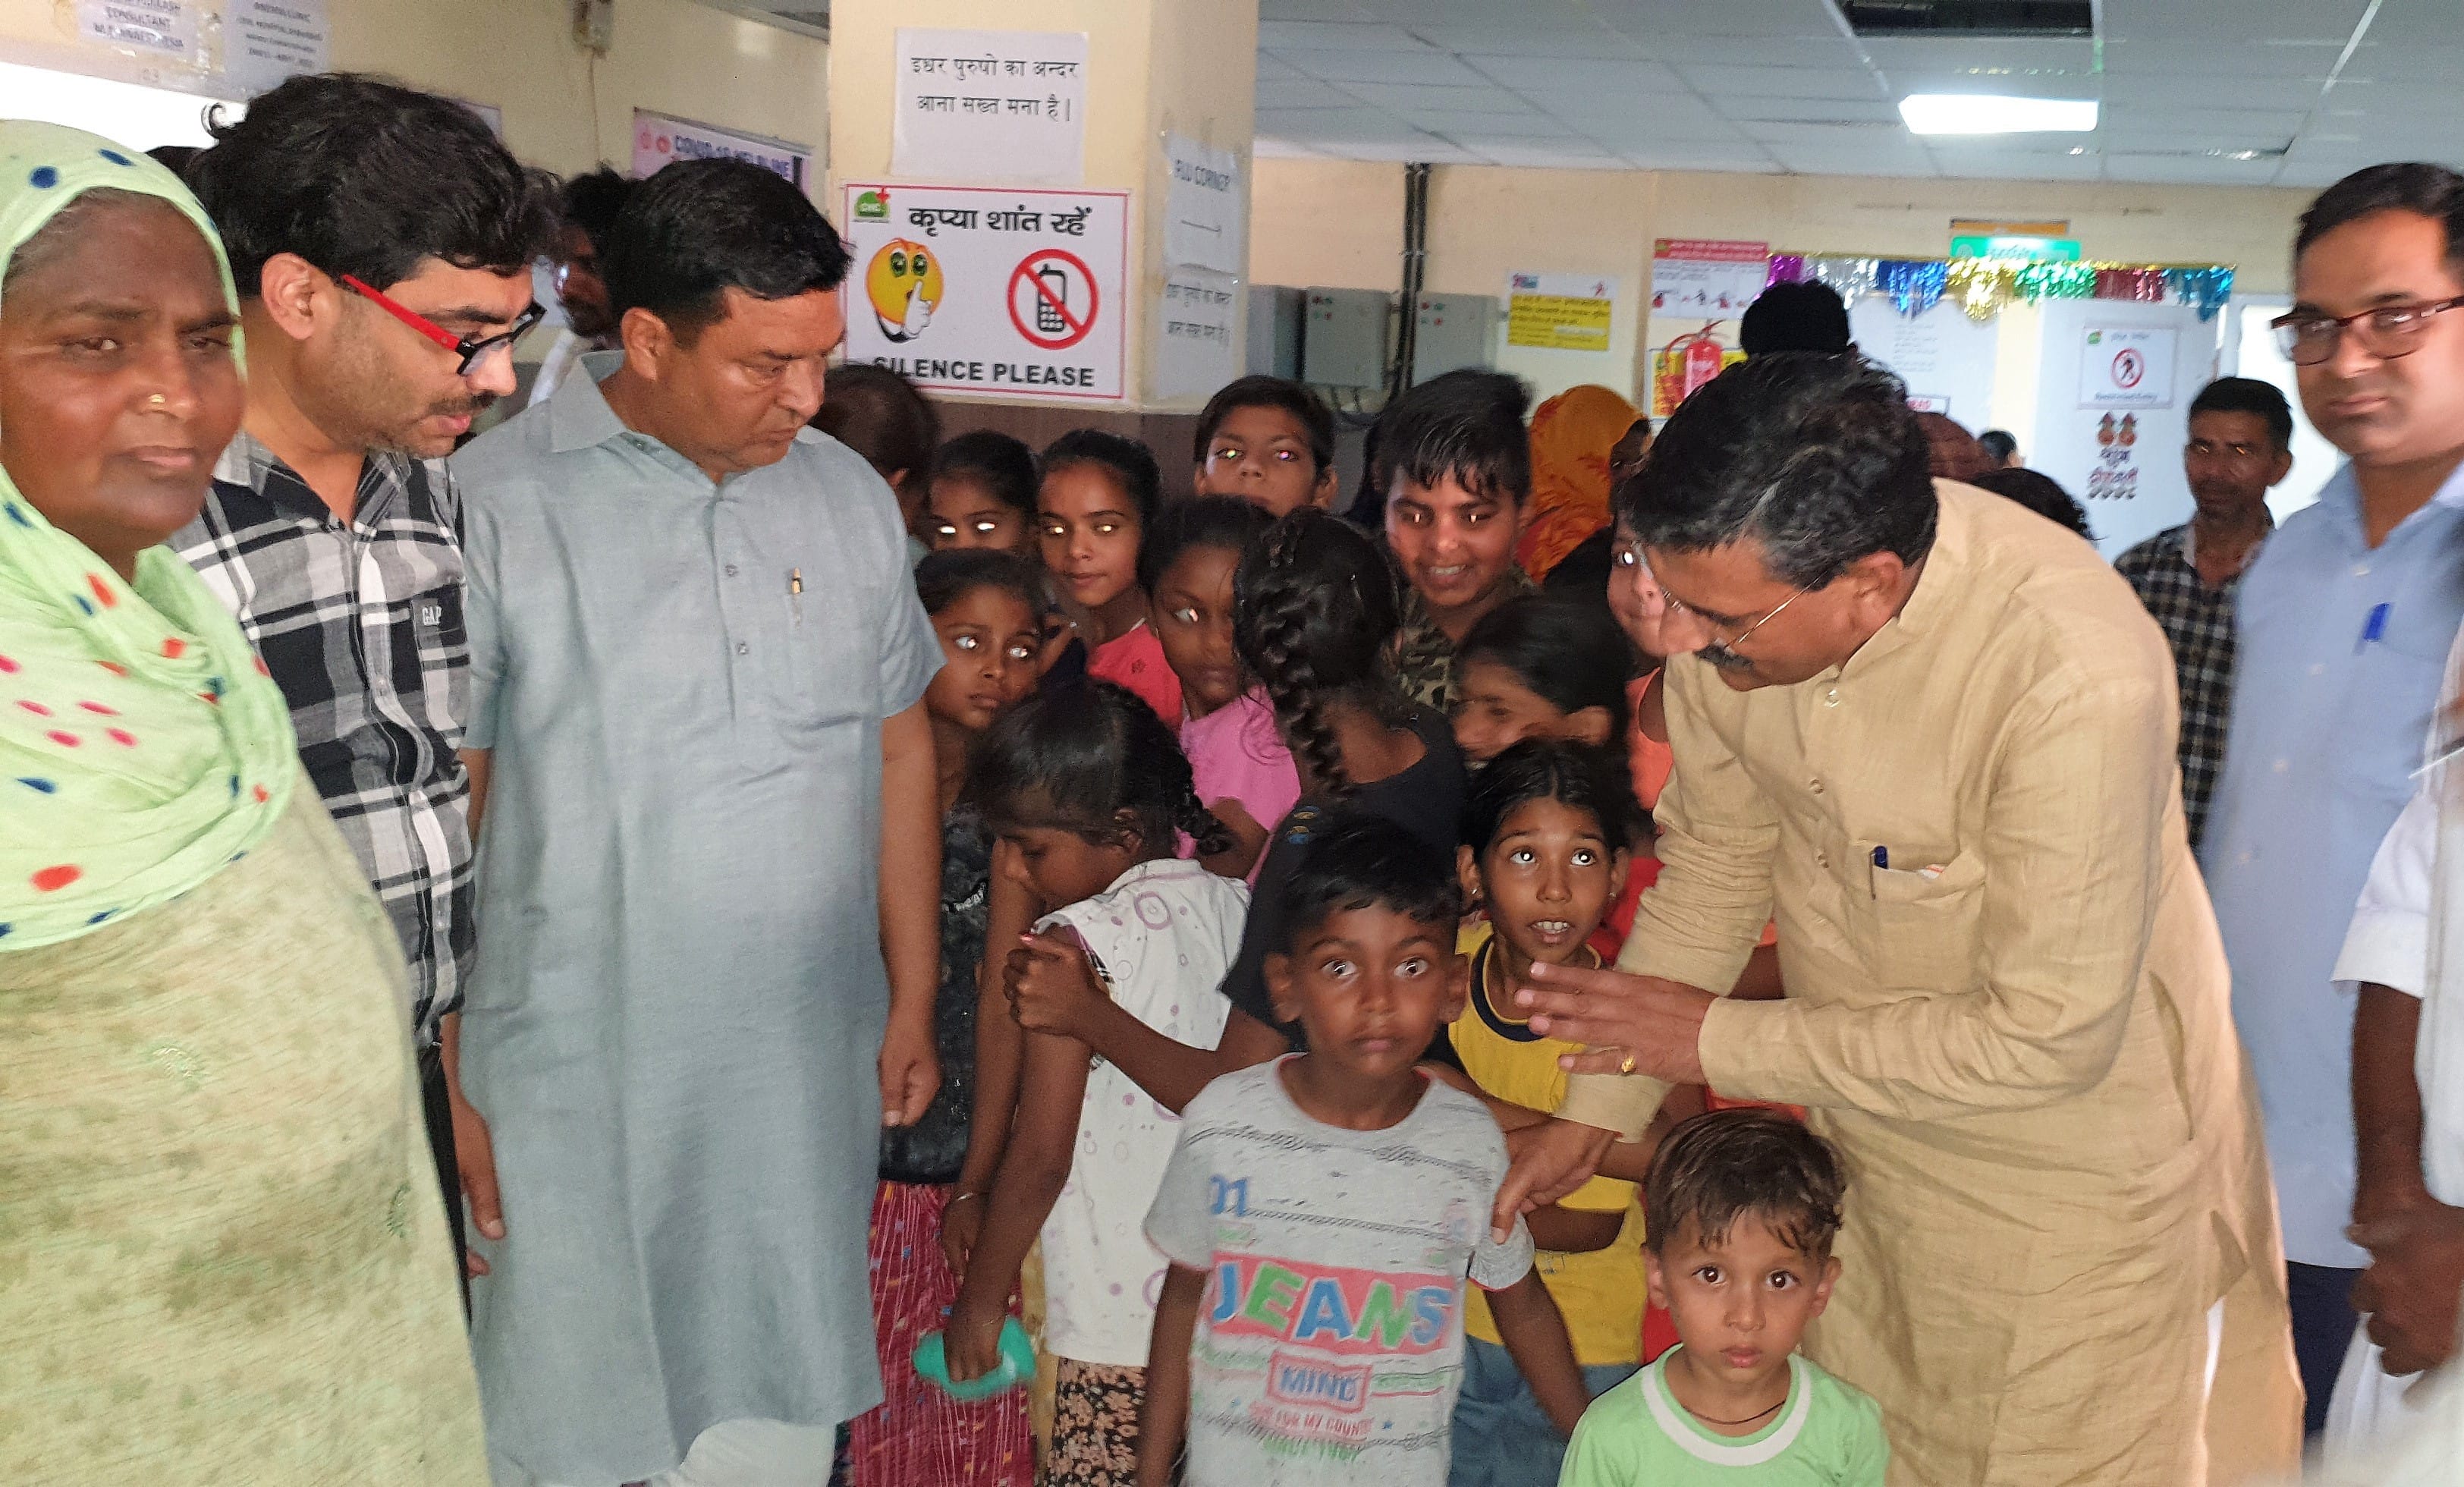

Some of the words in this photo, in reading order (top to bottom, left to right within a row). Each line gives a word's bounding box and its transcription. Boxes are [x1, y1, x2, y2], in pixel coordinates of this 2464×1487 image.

[910, 57, 948, 74] इधर
[1004, 60, 1027, 76] का
[1032, 61, 1080, 78] अन्दर
[917, 96, 957, 112] आना
[1007, 99, 1042, 115] मना
[908, 207, 979, 237] कृप्या
[987, 203, 1044, 232] शांत
[1050, 205, 1092, 237] रहें
[992, 363, 1095, 388] PLEASE
[1213, 1261, 1453, 1349] JEANS
